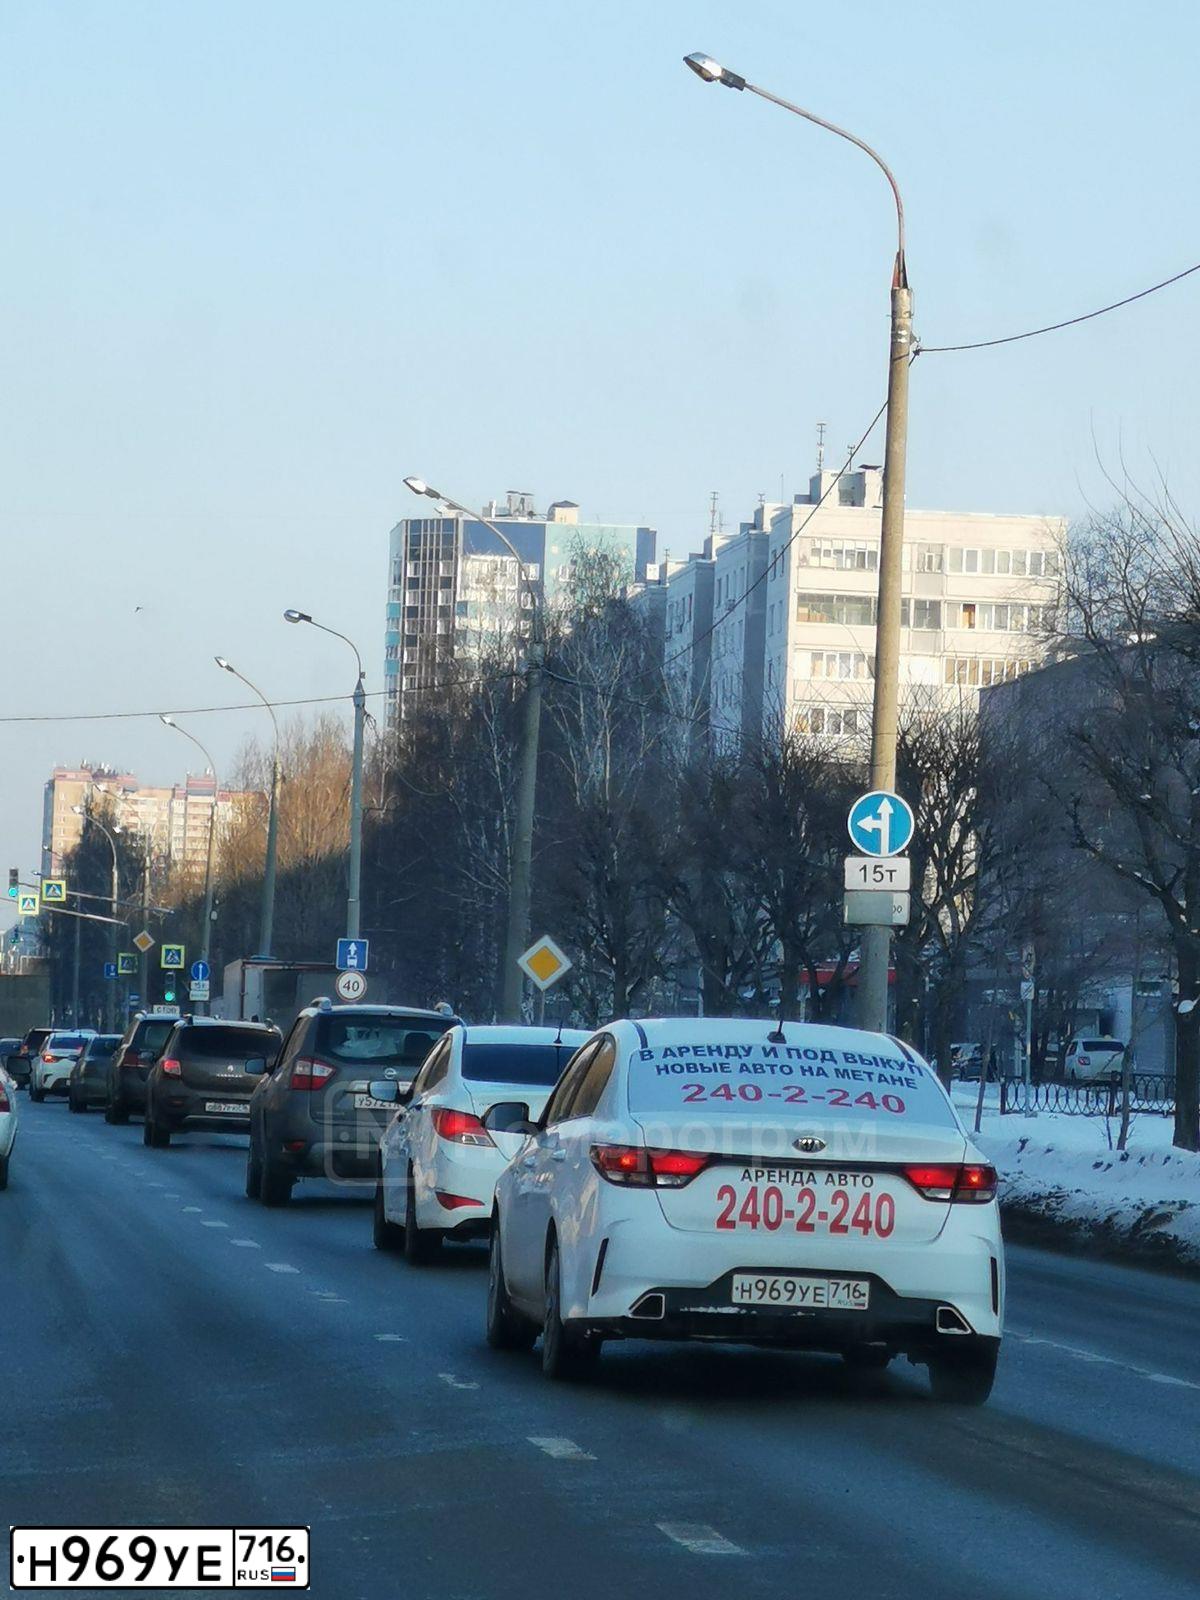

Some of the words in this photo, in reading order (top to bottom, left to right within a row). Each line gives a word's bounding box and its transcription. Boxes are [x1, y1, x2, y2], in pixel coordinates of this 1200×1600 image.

[859, 864, 897, 883] 15т
[343, 980, 360, 992] 40
[639, 1050, 655, 1062] В
[662, 1045, 752, 1060] АРЕНДУ
[763, 1046, 779, 1059] И
[787, 1046, 838, 1065] ПОД
[842, 1051, 924, 1078] ВЫКУП
[655, 1062, 732, 1077] НОВЫЕ
[738, 1062, 793, 1077] АВТО
[799, 1064, 829, 1079] НА
[835, 1068, 919, 1091] МЕТАНЕ
[681, 1083, 906, 1115] 240-2-240
[740, 1168, 818, 1188] АРЕНДА
[824, 1172, 874, 1189] АВТО
[716, 1184, 895, 1239] 240-2-240
[740, 1278, 826, 1304] Н969УЕ
[830, 1281, 862, 1301] 716
